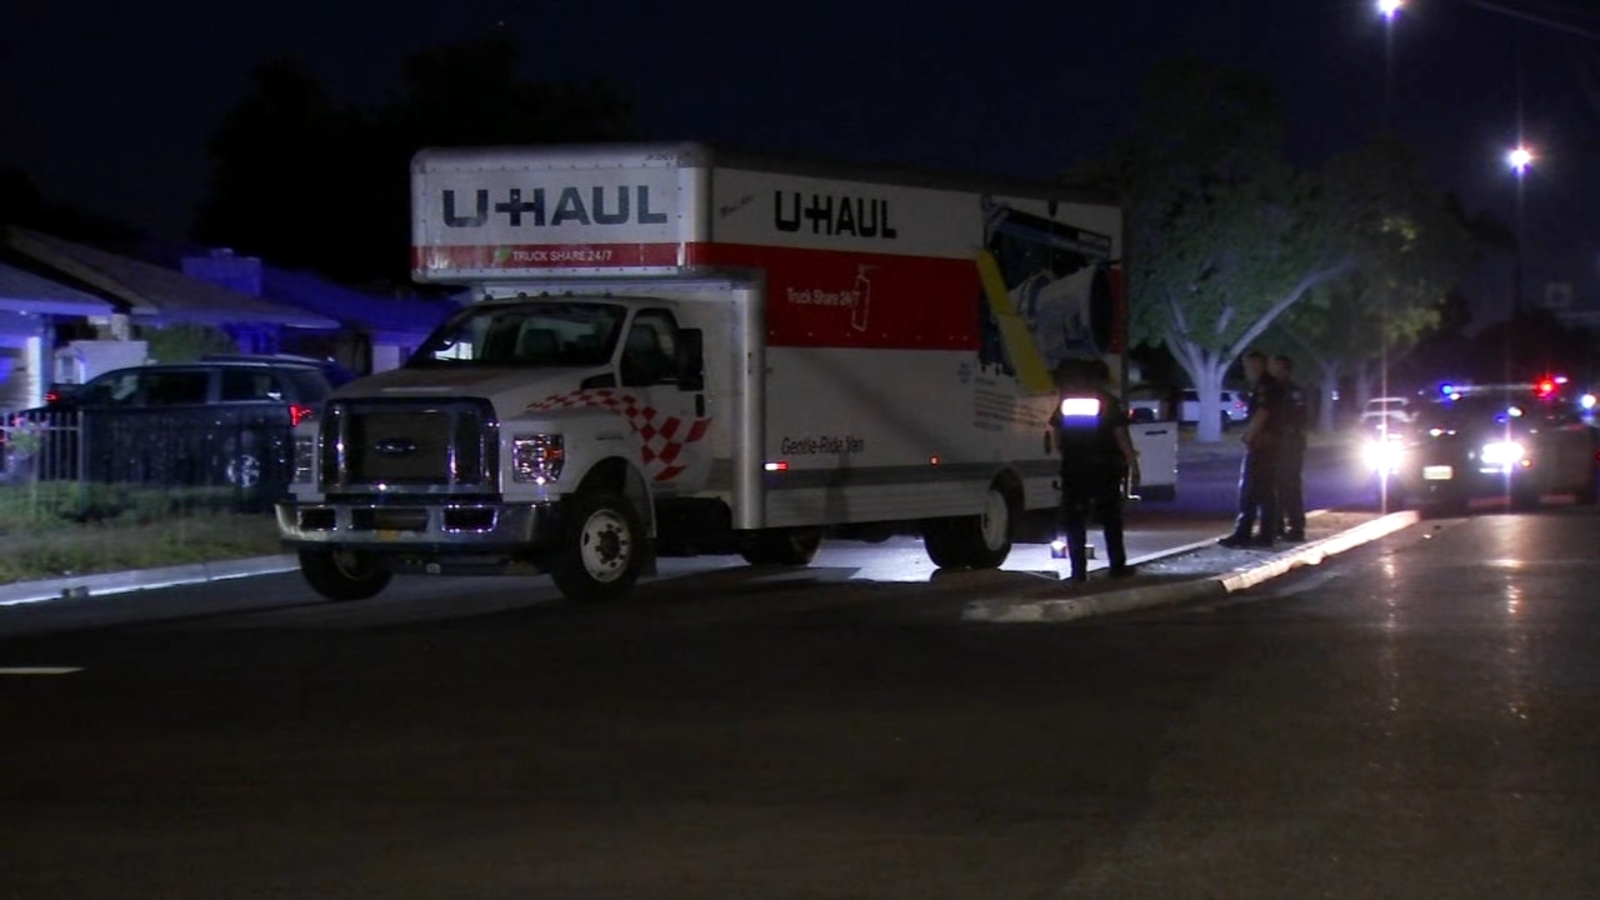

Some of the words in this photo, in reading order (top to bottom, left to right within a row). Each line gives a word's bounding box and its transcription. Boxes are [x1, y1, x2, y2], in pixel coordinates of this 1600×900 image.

[442, 185, 668, 228] U-HAUL
[775, 190, 897, 239] U-HAUL
[512, 250, 548, 262] TRUCK
[549, 250, 586, 262] SHARE
[587, 249, 613, 262] 24/7
